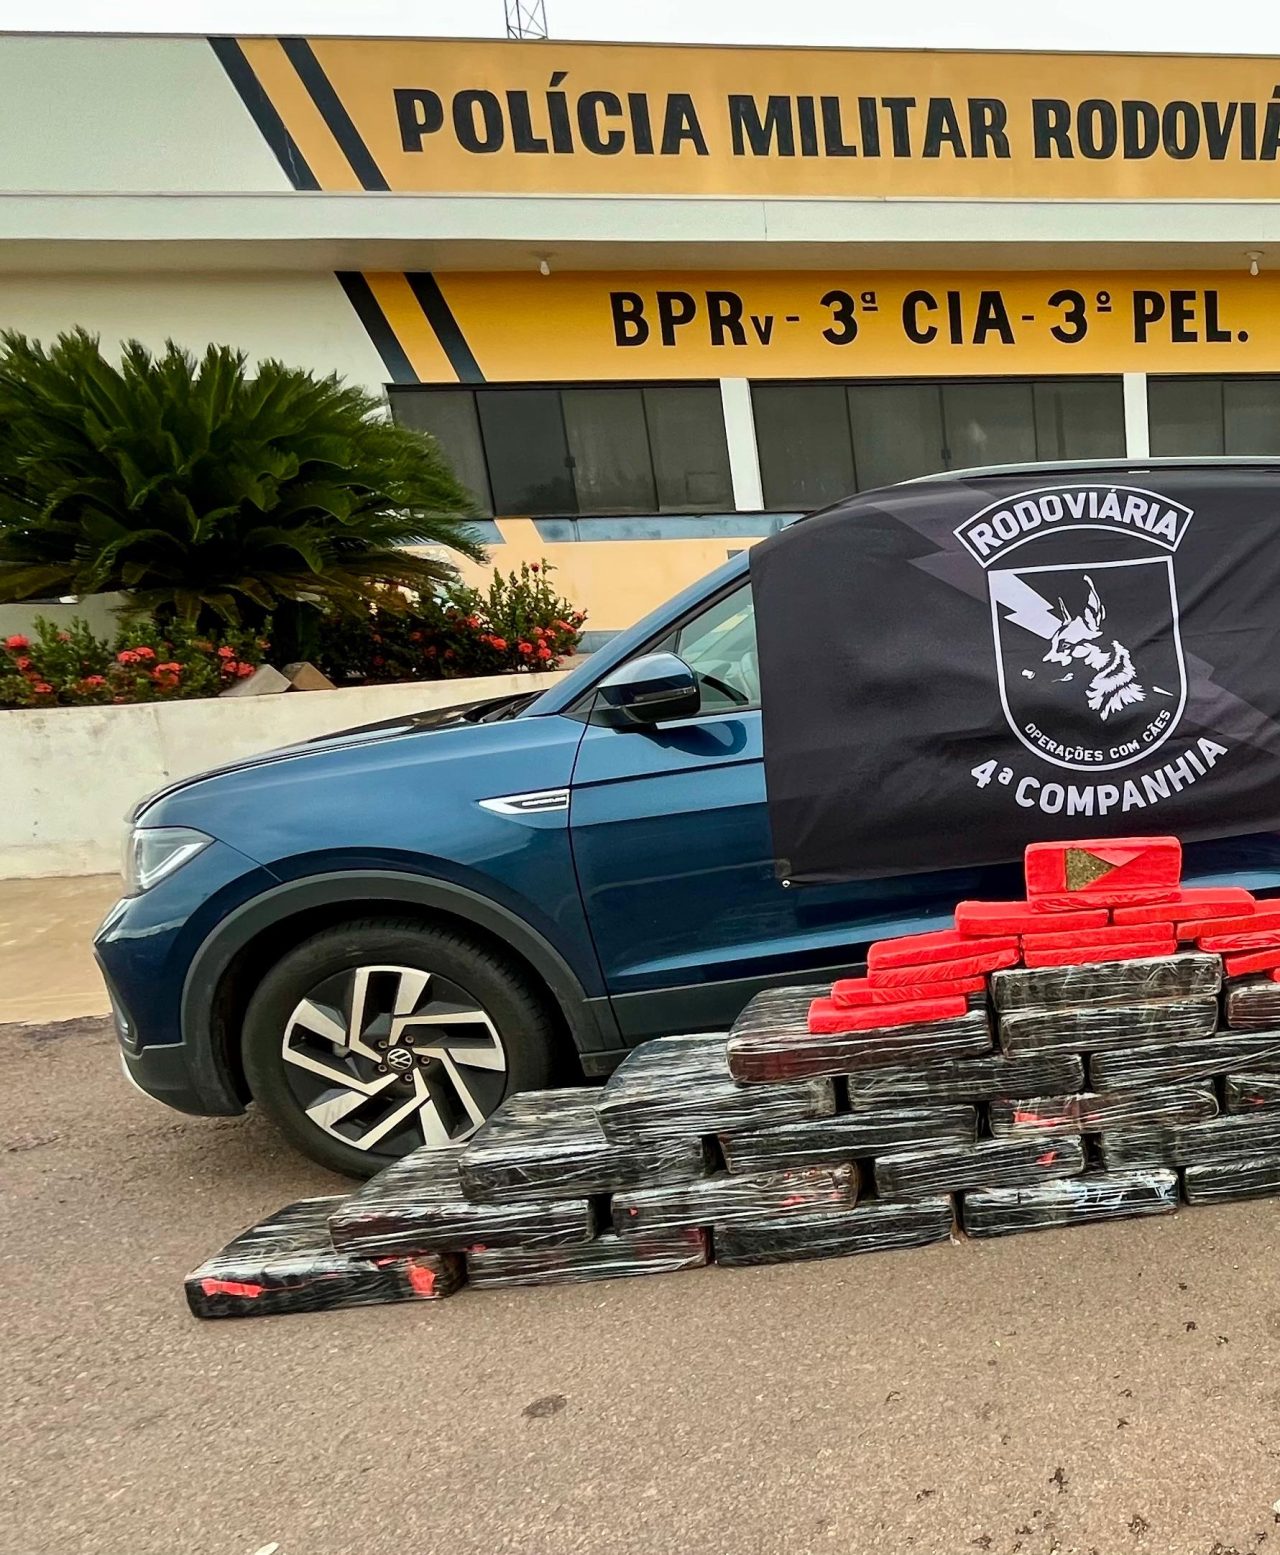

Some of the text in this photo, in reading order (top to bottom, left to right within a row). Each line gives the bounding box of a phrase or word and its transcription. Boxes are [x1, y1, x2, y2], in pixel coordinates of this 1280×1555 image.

[392, 71, 709, 155] POLÍCIA
[727, 94, 1011, 160] MILITAR
[1132, 289, 1249, 343] PEL.
[967, 489, 1179, 556] RODOVIÁRIA
[1024, 709, 1171, 762] OPERAÇÕES COM CÃES
[1015, 736, 1229, 817] COMPANHIA
